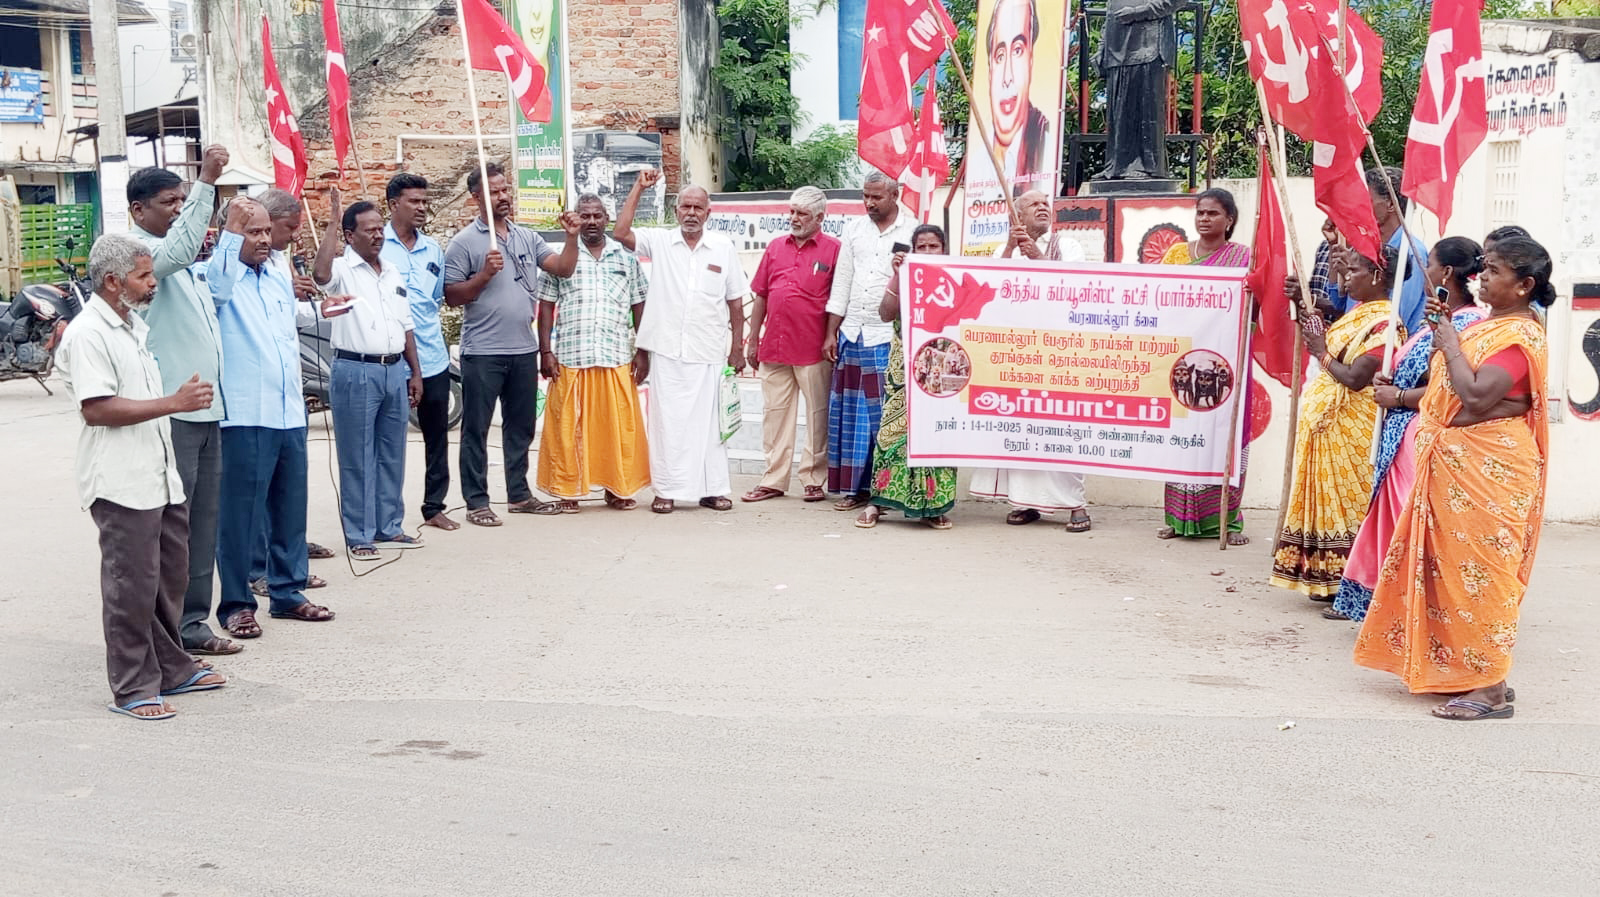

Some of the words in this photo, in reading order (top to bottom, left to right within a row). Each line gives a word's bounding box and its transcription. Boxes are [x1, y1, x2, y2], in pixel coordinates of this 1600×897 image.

[968, 194, 1009, 218] அண்
[759, 213, 791, 233] வருங்க
[970, 218, 1008, 238] பிறந்தநா
[1000, 277, 1040, 304] இந்திய
[1047, 278, 1115, 309] கம்யூனிஸ்ட்
[1121, 283, 1148, 306] கட்சி
[1155, 284, 1233, 313] (மார்க்சிஸ்ட்)
[964, 329, 1037, 349] பெரணமல்லூர்
[1090, 334, 1133, 353] நாய்கள்
[1139, 336, 1180, 357] மற்றும்
[990, 348, 1043, 366] குரங்குகள்
[1049, 352, 1151, 375] தொல்லையிலிருந்து
[1000, 367, 1044, 385] மக்களை
[1050, 371, 1079, 387] காக்க
[1085, 373, 1140, 393] வற்புறுத்தி
[974, 388, 1167, 422] ஆர்ப்பாட்டம்
[935, 416, 957, 433] நாள்
[970, 420, 1022, 433] 14-11-2025
[1169, 433, 1206, 449] அருகில்
[1004, 438, 1030, 452] நேரம்
[1043, 443, 1073, 454] காலை
[1078, 444, 1105, 456] 10.00
[1110, 446, 1133, 459] மணி
